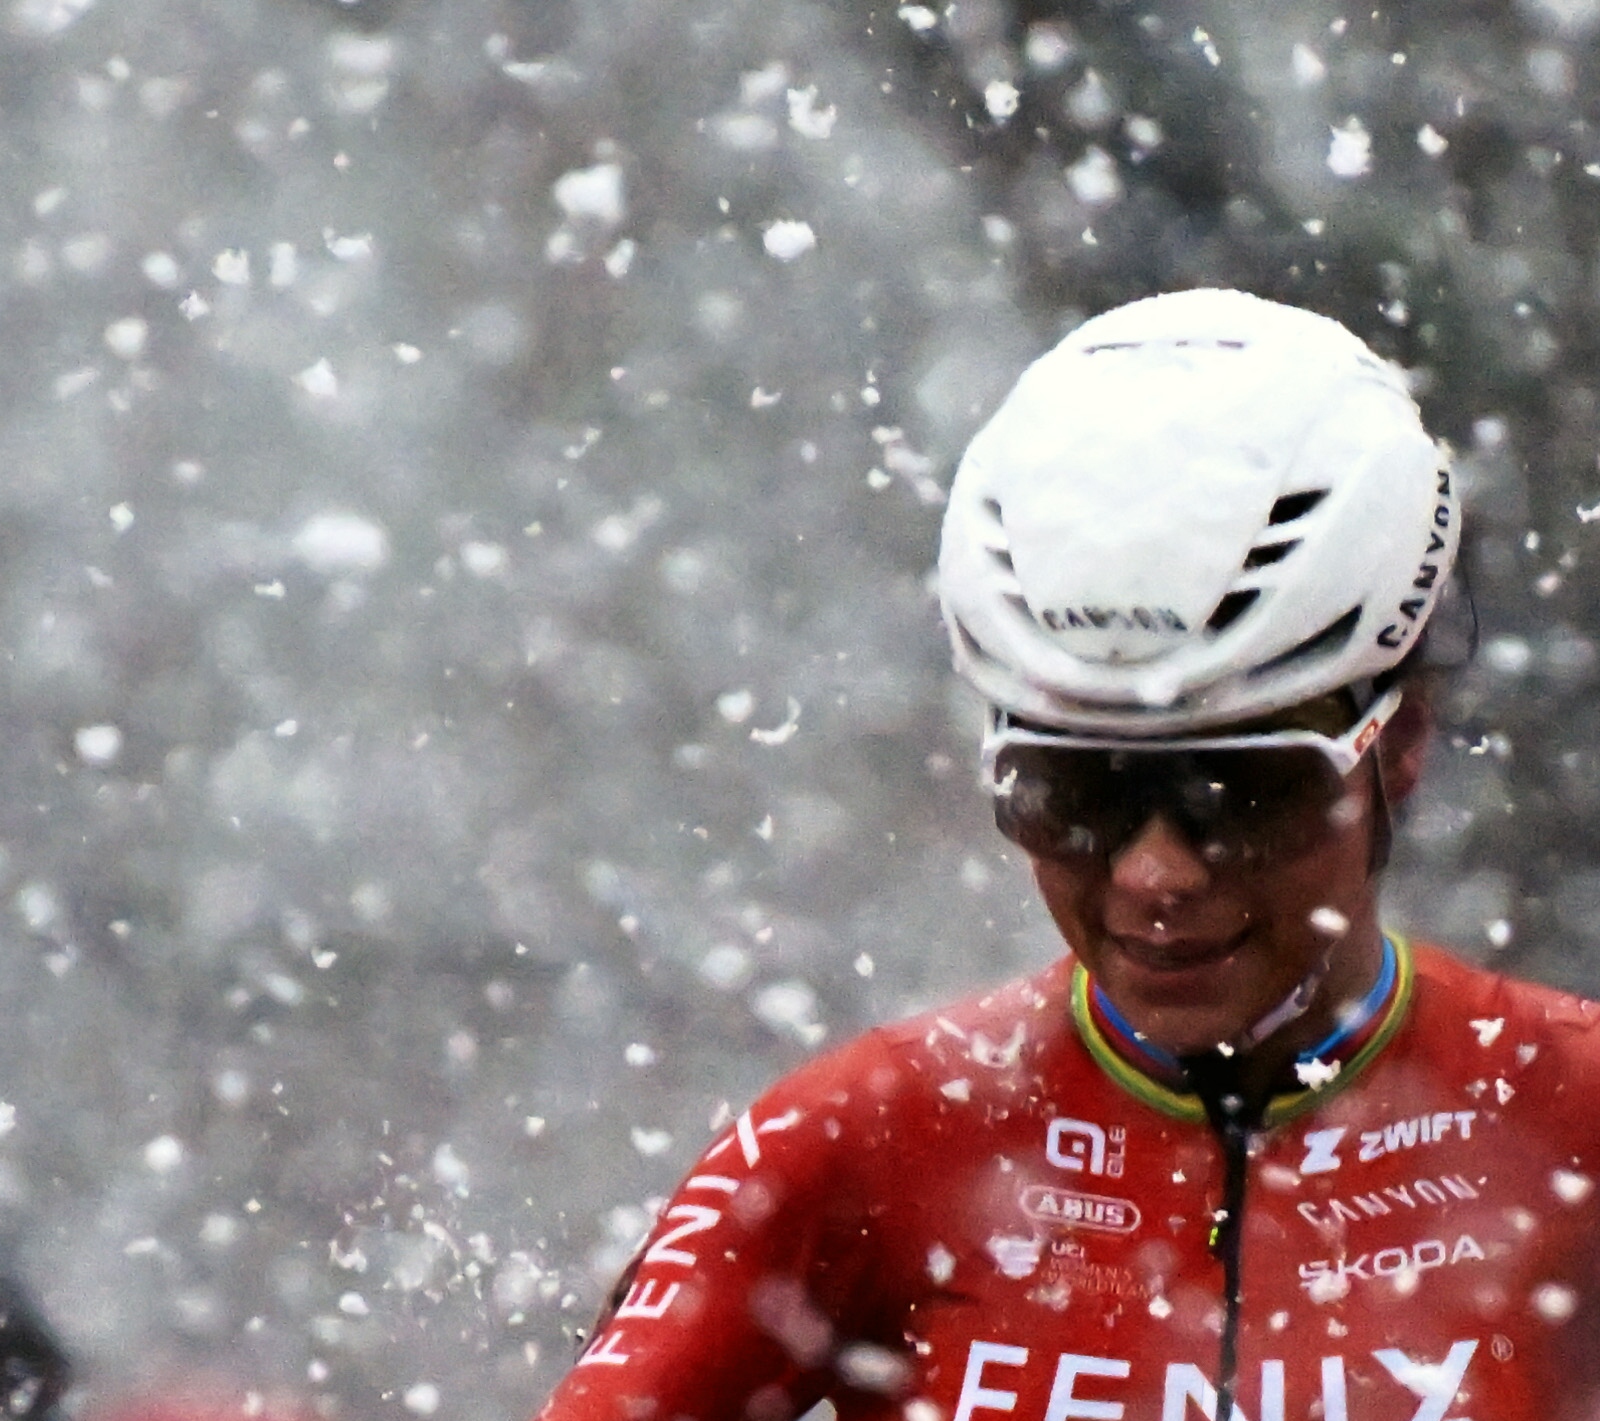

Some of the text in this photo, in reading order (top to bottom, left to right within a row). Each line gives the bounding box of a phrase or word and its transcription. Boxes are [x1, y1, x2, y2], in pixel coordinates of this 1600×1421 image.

[1358, 1109, 1477, 1163] ZWIFT
[1036, 1193, 1125, 1226] ABUS
[1297, 1174, 1480, 1226] CANYON
[577, 1109, 800, 1366] FENIX
